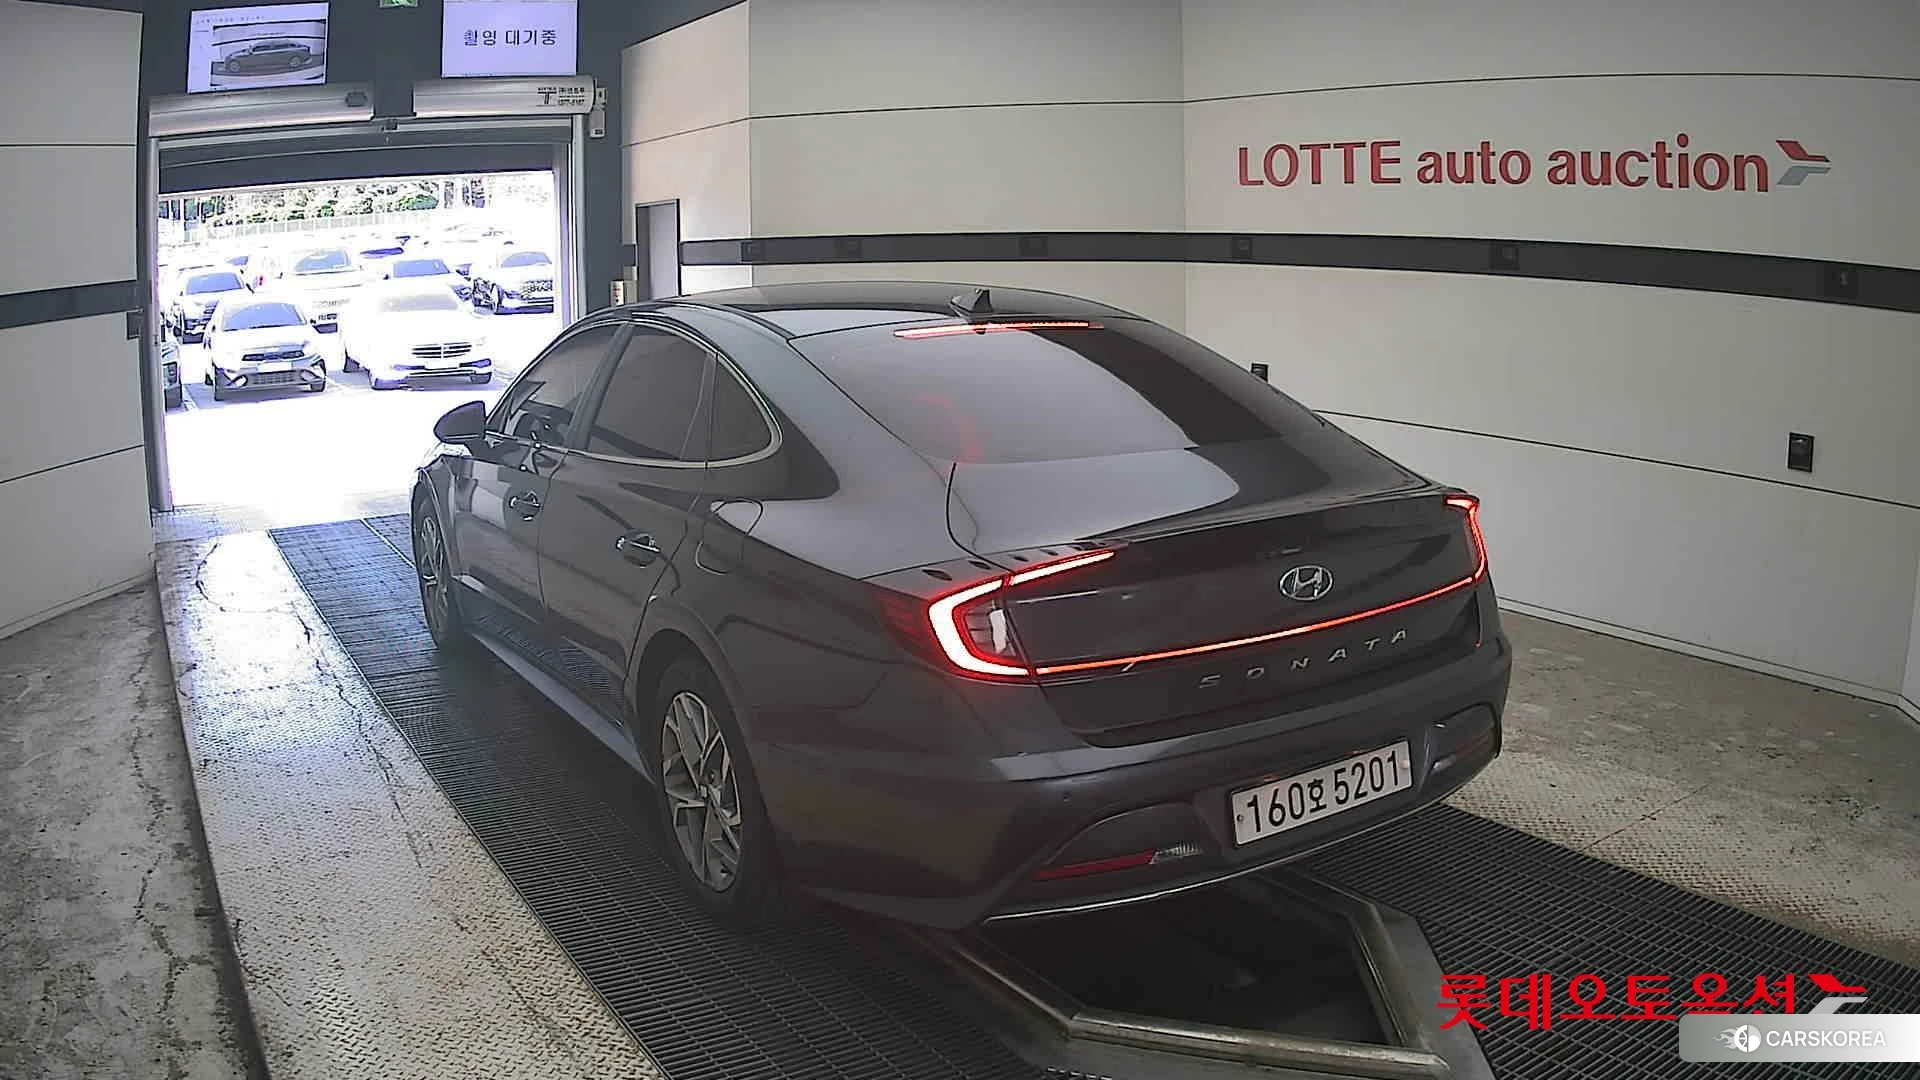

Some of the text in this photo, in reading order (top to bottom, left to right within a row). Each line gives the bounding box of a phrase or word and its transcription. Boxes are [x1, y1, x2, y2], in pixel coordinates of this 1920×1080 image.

[505, 29, 557, 46] 대기중
[1238, 134, 1769, 193] LOTTE auto auction
[1198, 628, 1407, 689] SONATA
[1247, 750, 1398, 833] 160호 5201
